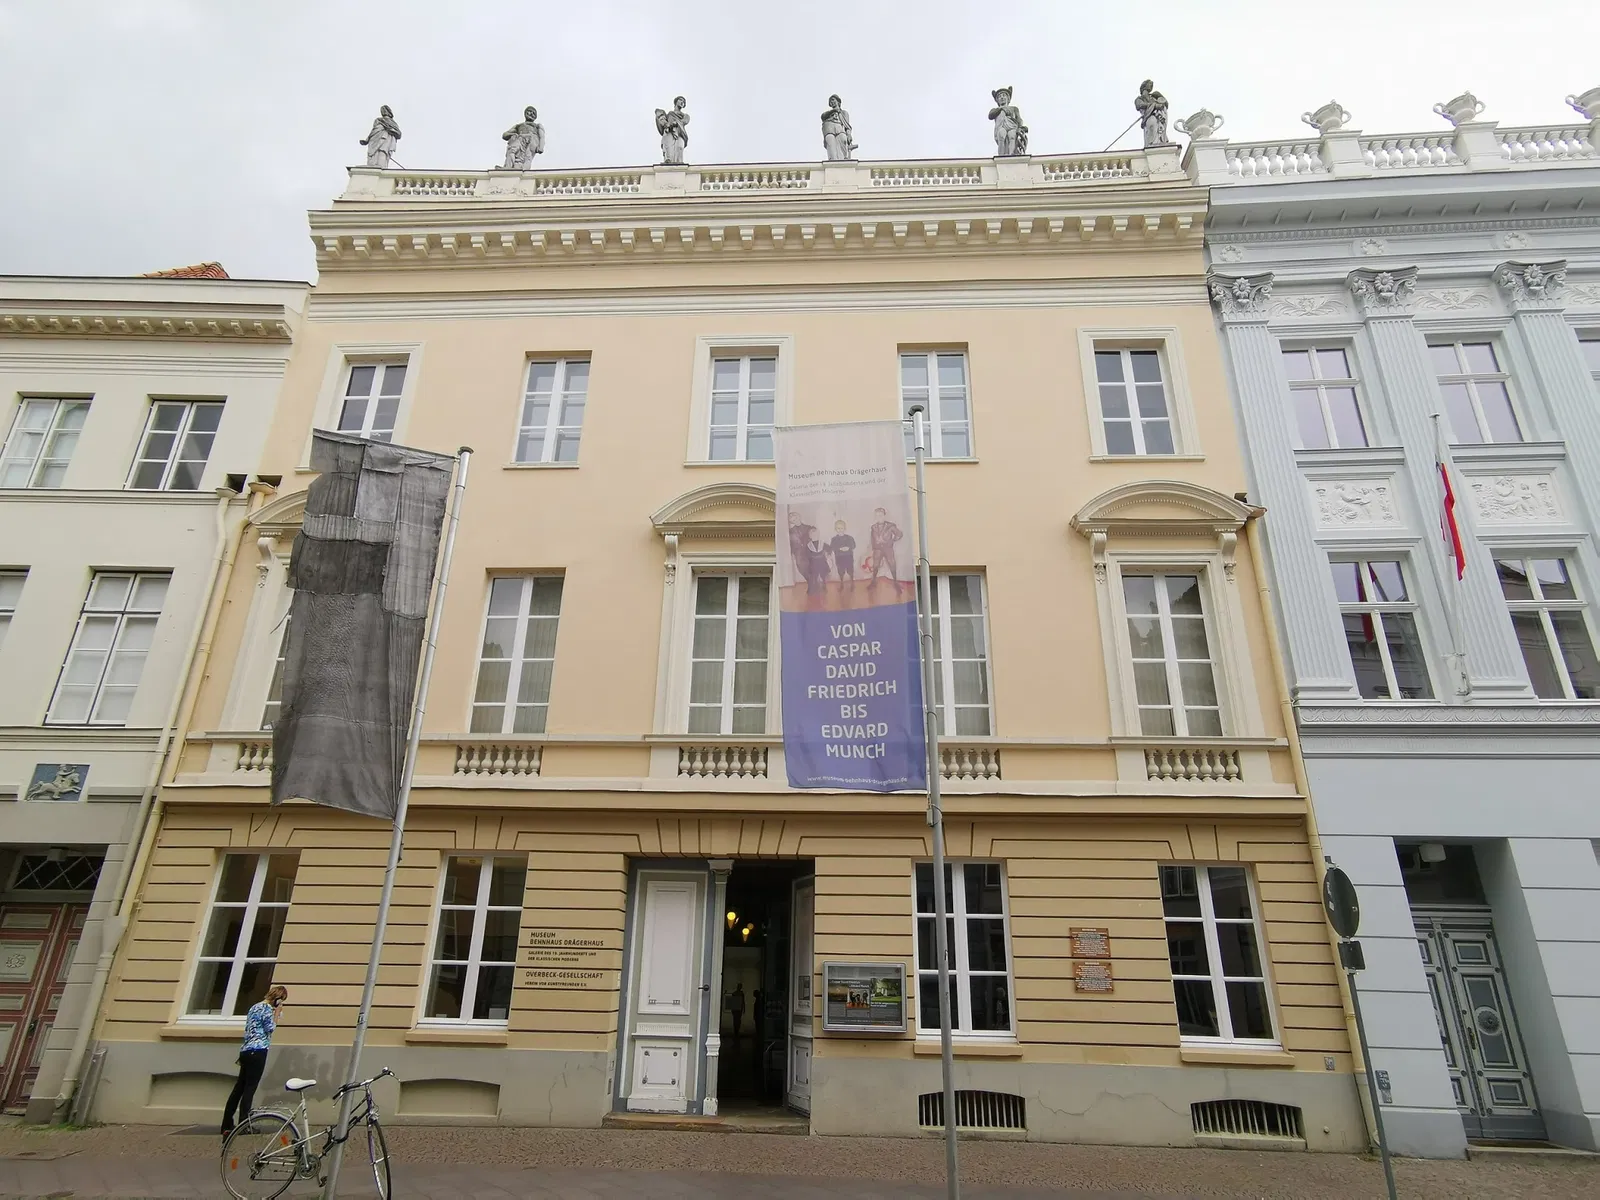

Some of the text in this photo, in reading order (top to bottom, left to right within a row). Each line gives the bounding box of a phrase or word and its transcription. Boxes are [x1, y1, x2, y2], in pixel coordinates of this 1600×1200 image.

[788, 466, 887, 480] Museum Behnhaus Drägerhaus
[830, 622, 865, 639] VON
[817, 641, 882, 659] CASPAR
[825, 662, 877, 679] DAVID
[807, 680, 897, 699] FRIEDRICH
[840, 704, 868, 719] BIS
[821, 722, 888, 739] EDVARD
[825, 742, 885, 759] MUNCH
[564, 939, 604, 947] DRÄGERHAUS
[525, 971, 604, 979] OVERBECK-GESELLSCHAFT
